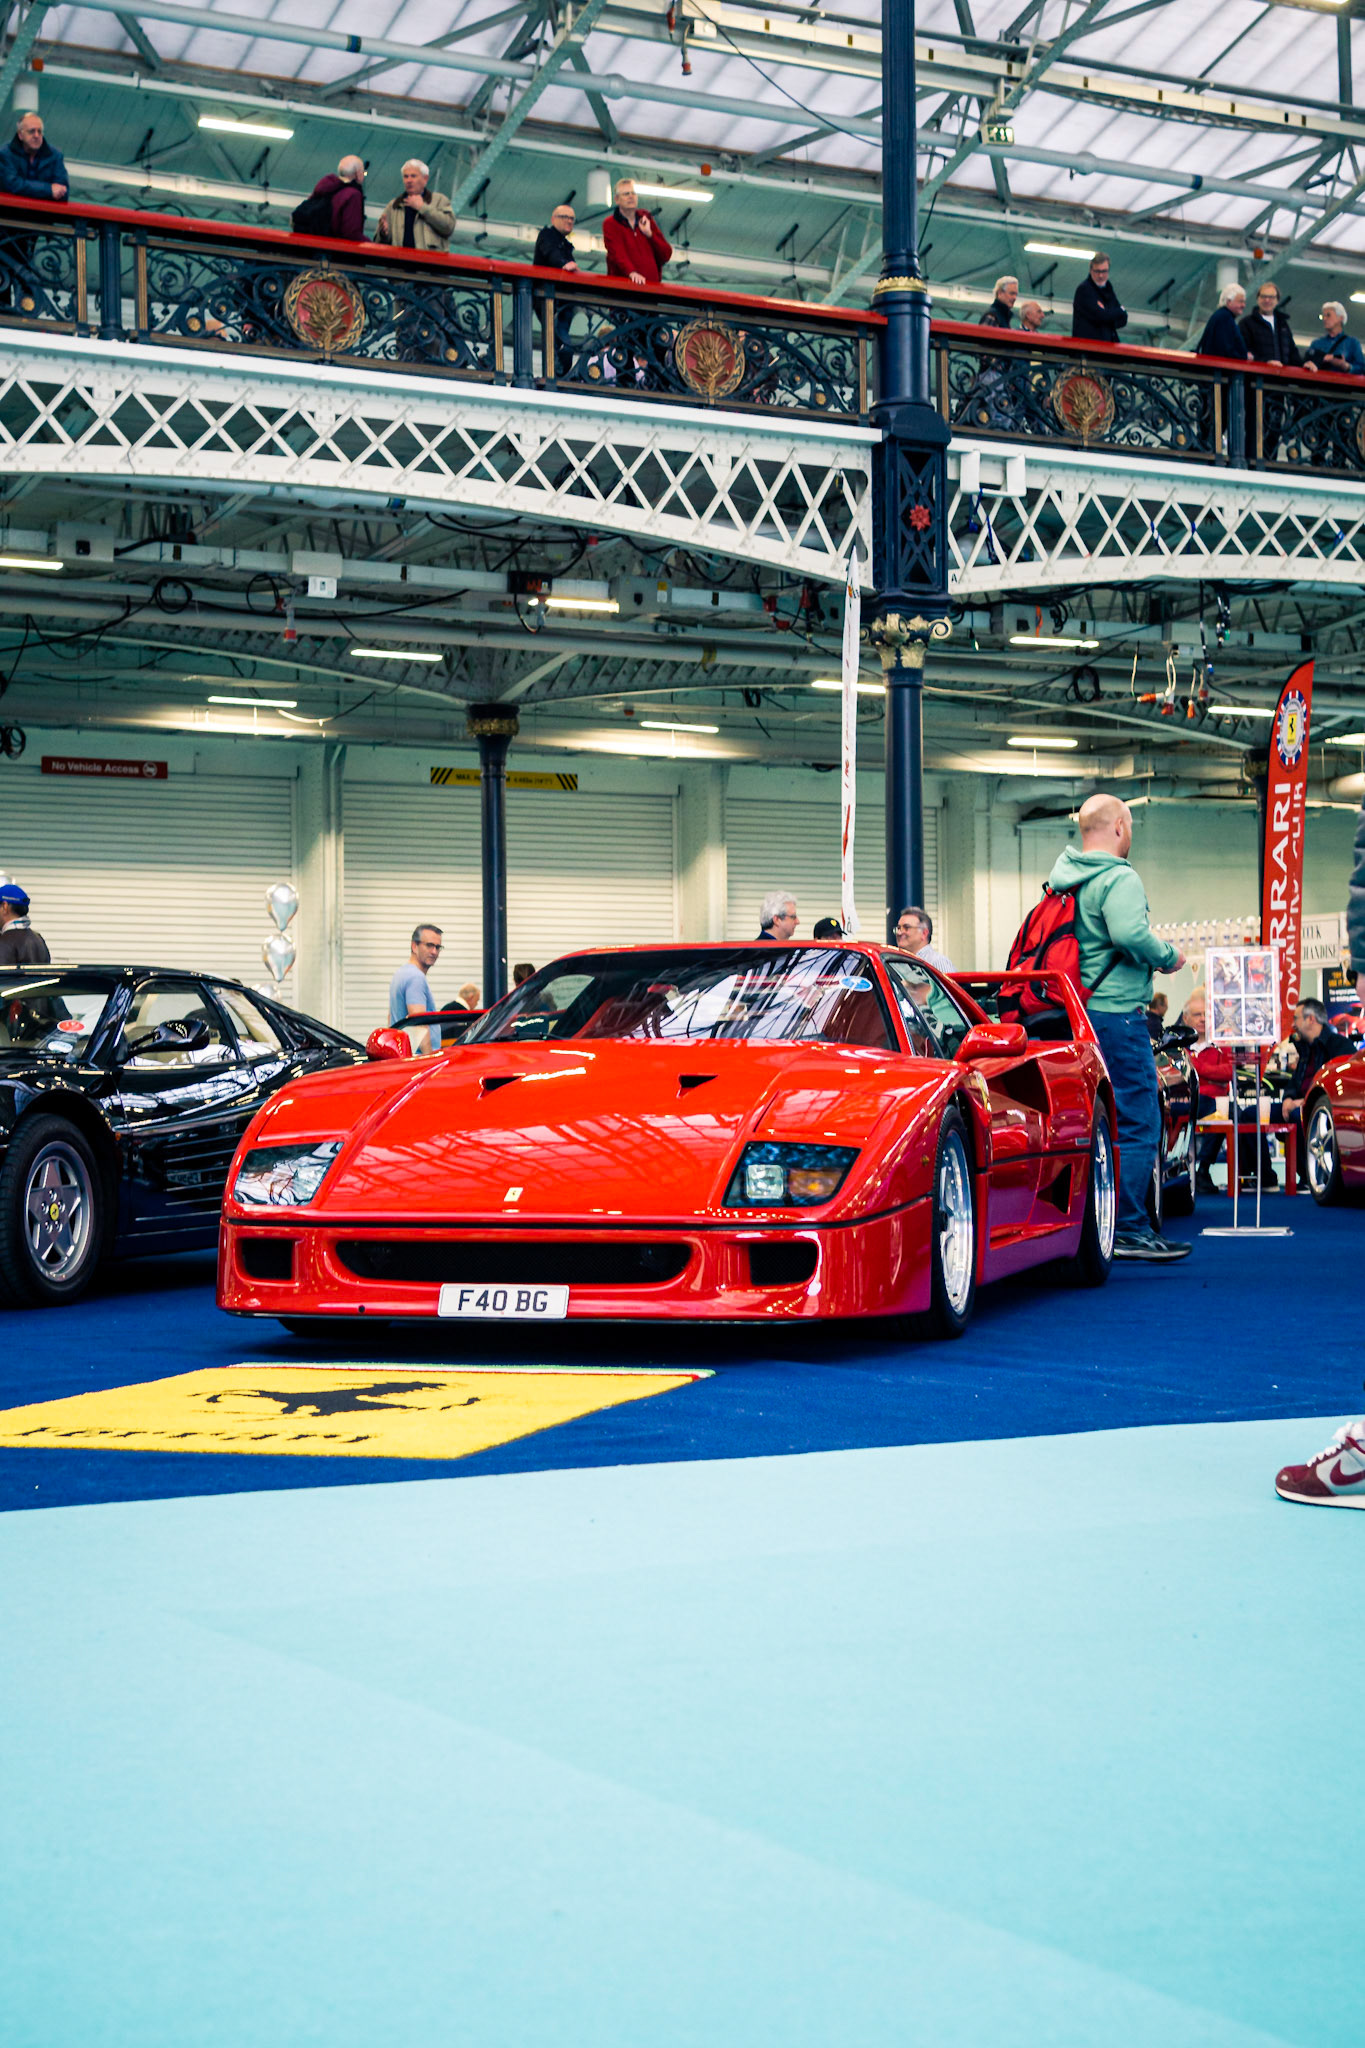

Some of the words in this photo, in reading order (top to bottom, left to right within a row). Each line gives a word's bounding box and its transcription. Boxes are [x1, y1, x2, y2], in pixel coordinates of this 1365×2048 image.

[52, 761, 66, 771] No
[67, 762, 102, 773] Vehicle
[105, 764, 139, 774] Access
[1269, 783, 1291, 966] RRARI
[1303, 944, 1336, 961] HANDISE
[458, 1289, 509, 1311] F40
[515, 1290, 549, 1312] BG
